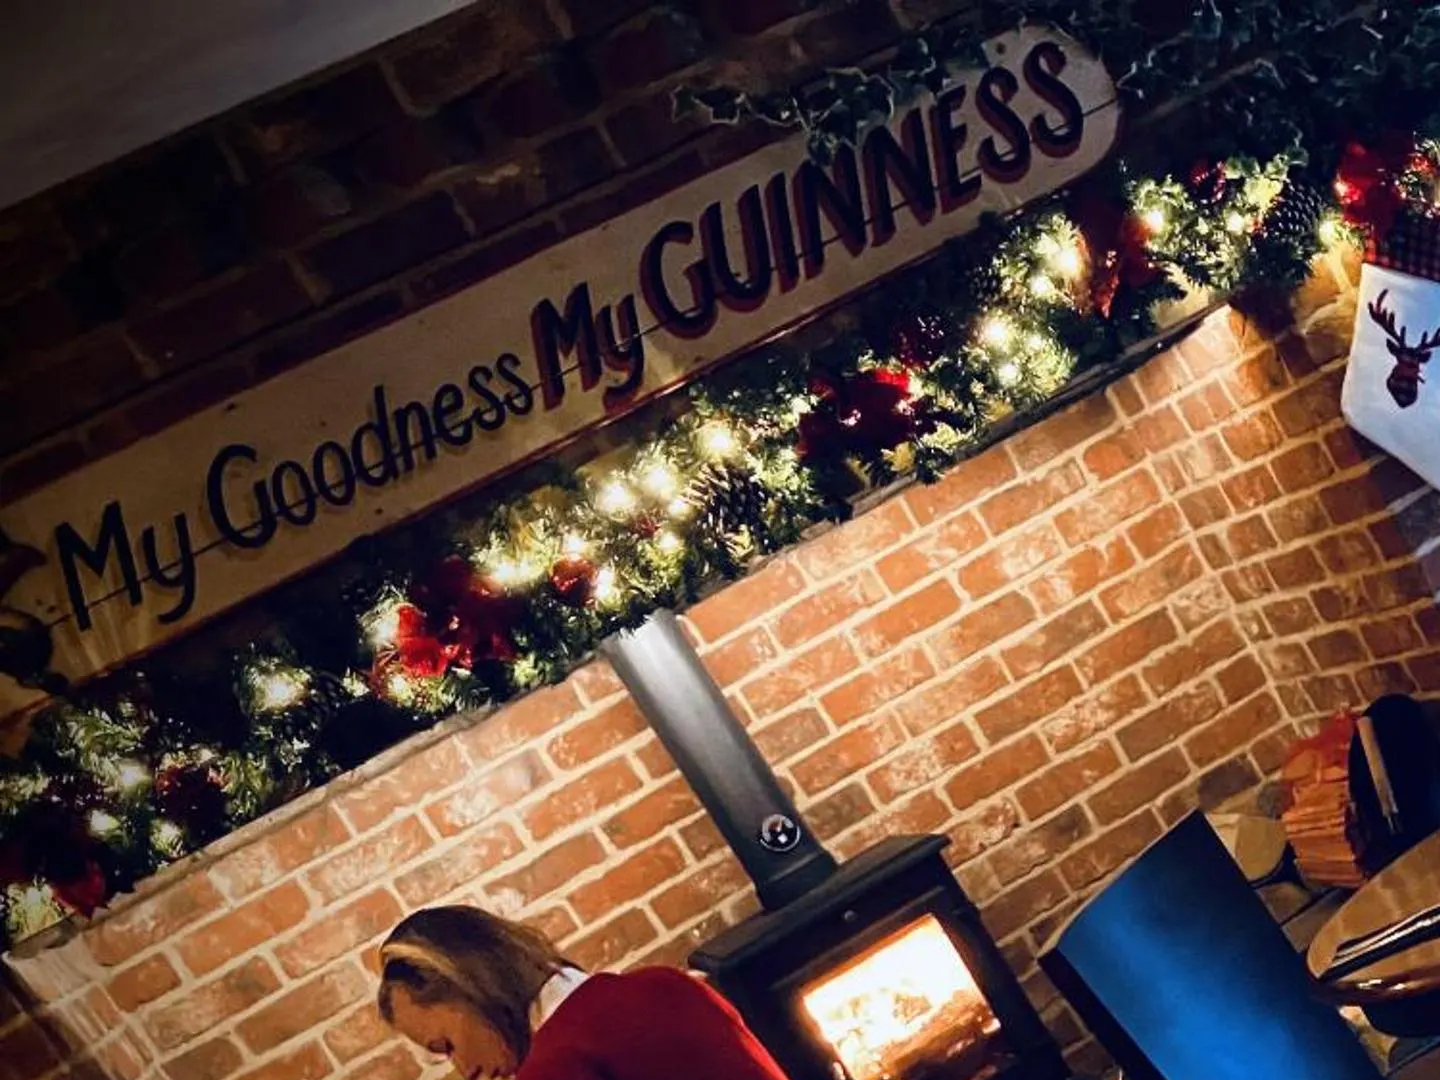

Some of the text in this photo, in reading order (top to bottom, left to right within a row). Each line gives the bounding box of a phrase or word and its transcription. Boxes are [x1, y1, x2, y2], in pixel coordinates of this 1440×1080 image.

[54, 41, 1084, 632] My Goodness My GUINNESS
